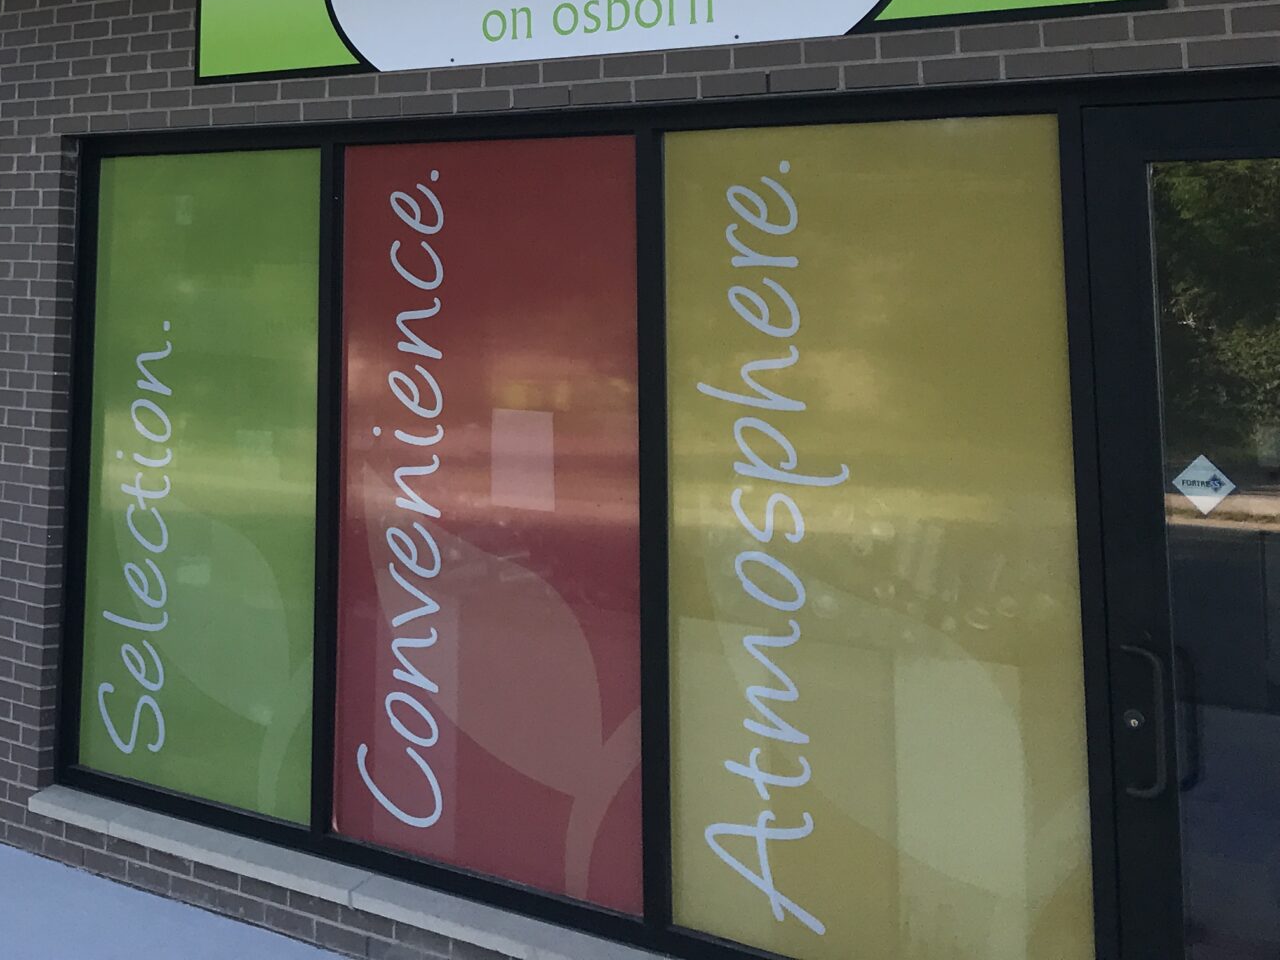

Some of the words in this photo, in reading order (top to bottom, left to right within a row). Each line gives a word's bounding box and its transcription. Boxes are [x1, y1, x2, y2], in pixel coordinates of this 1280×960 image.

[482, 6, 533, 42] on
[97, 319, 173, 754] Selection.
[356, 168, 445, 828] Convenience.
[696, 159, 851, 937] Atmosphere.
